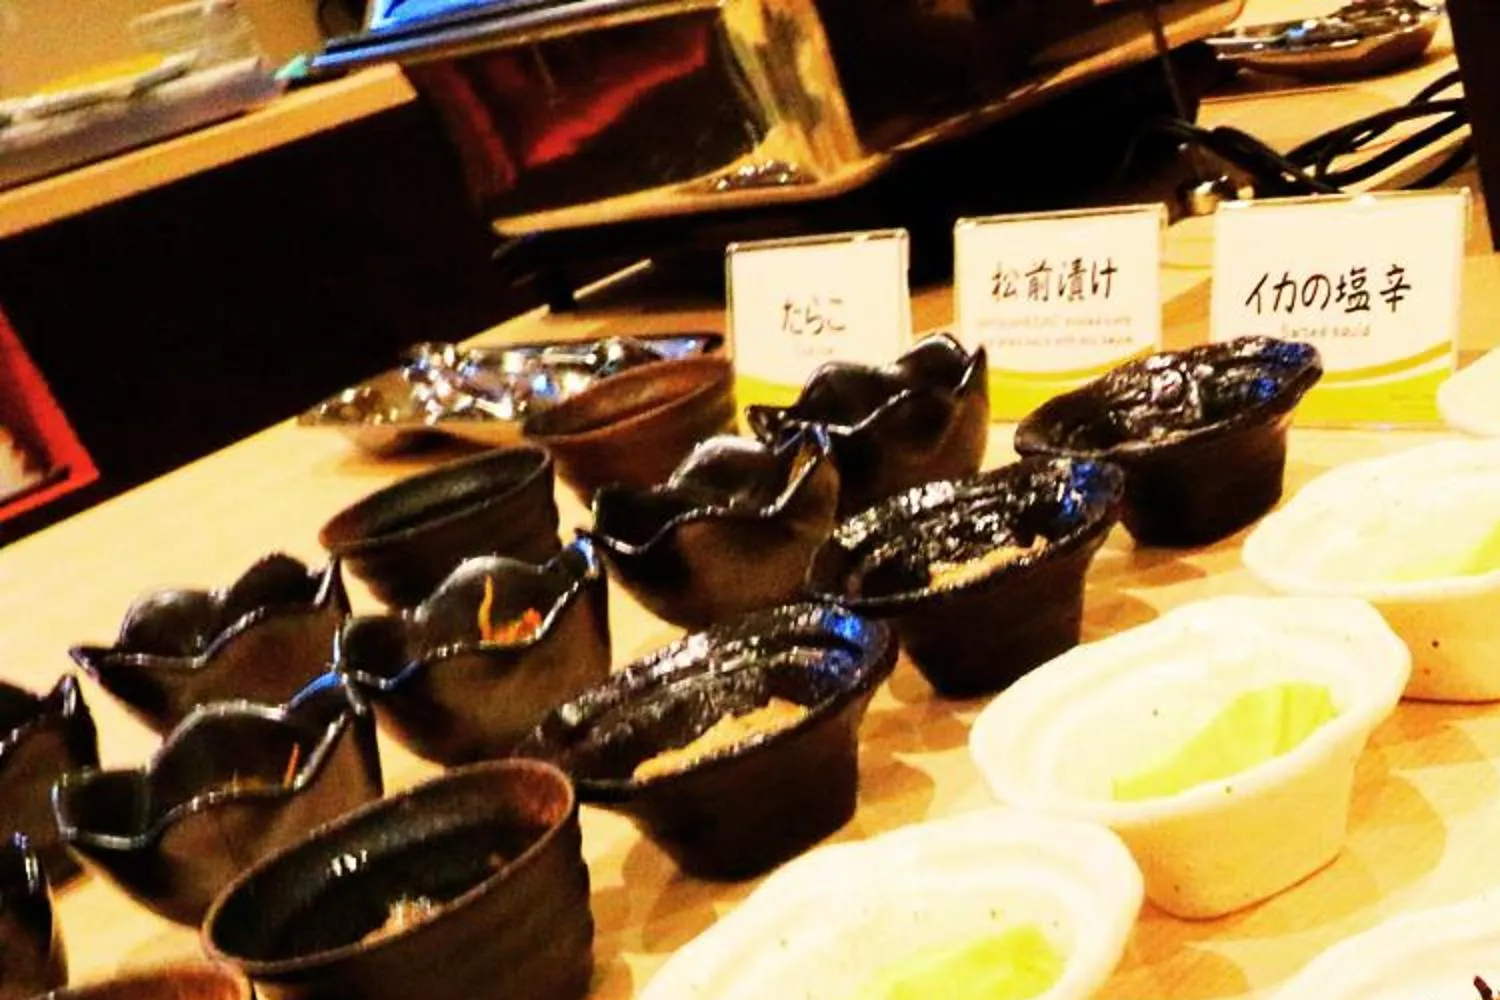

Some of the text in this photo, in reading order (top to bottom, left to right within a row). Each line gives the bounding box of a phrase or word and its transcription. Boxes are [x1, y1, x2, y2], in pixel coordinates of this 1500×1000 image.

[991, 257, 1119, 303] 松前漬け
[1244, 263, 1413, 315] イカの塩辛
[781, 294, 846, 336] たらこ
